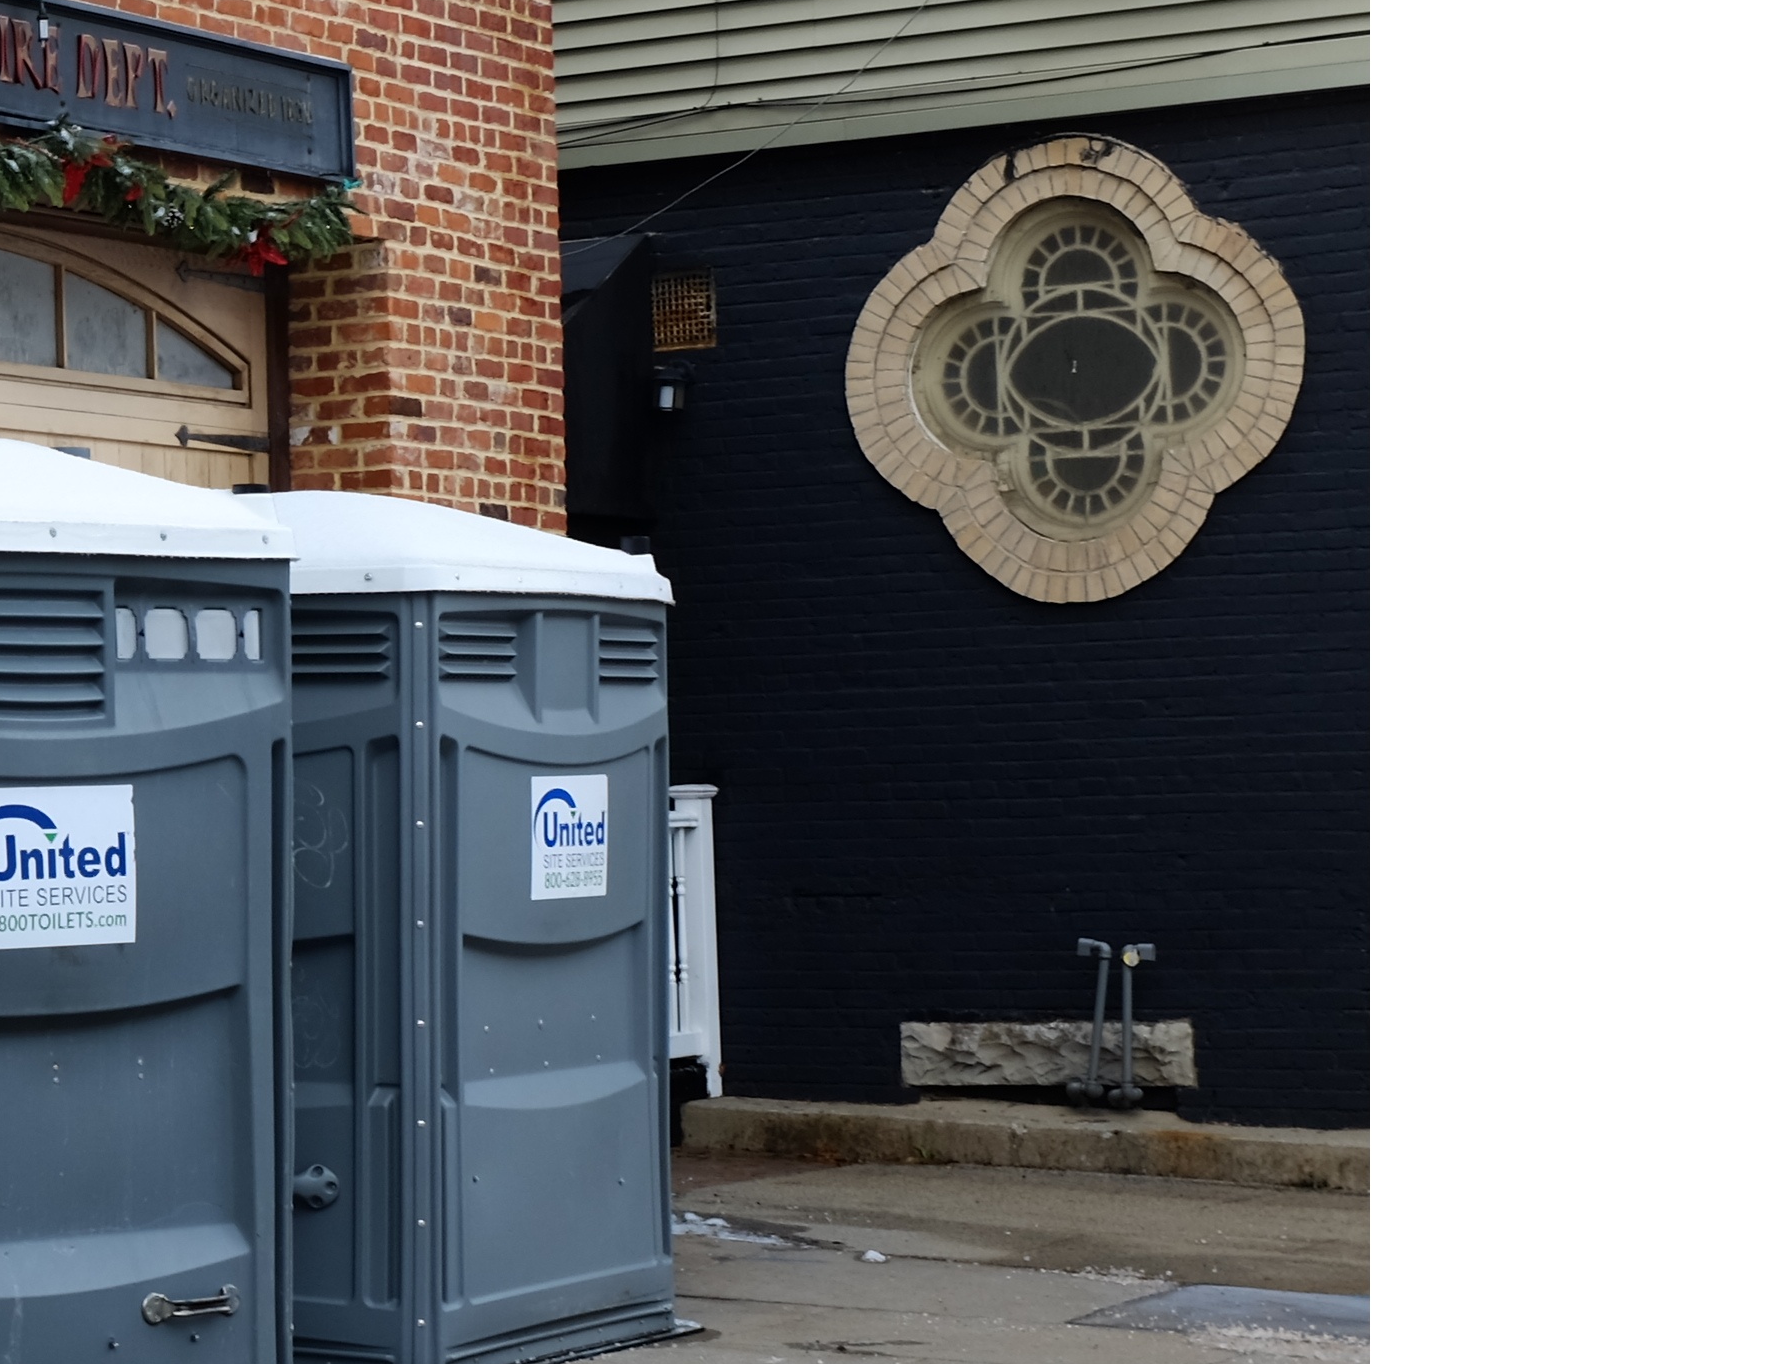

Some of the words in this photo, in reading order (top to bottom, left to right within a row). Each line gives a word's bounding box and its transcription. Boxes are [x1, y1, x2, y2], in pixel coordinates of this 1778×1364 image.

[75, 33, 178, 119] DEPT.
[543, 810, 605, 848] United
[542, 853, 563, 869] SITE
[565, 851, 605, 868] SERVICES
[36, 884, 128, 907] SERVICES
